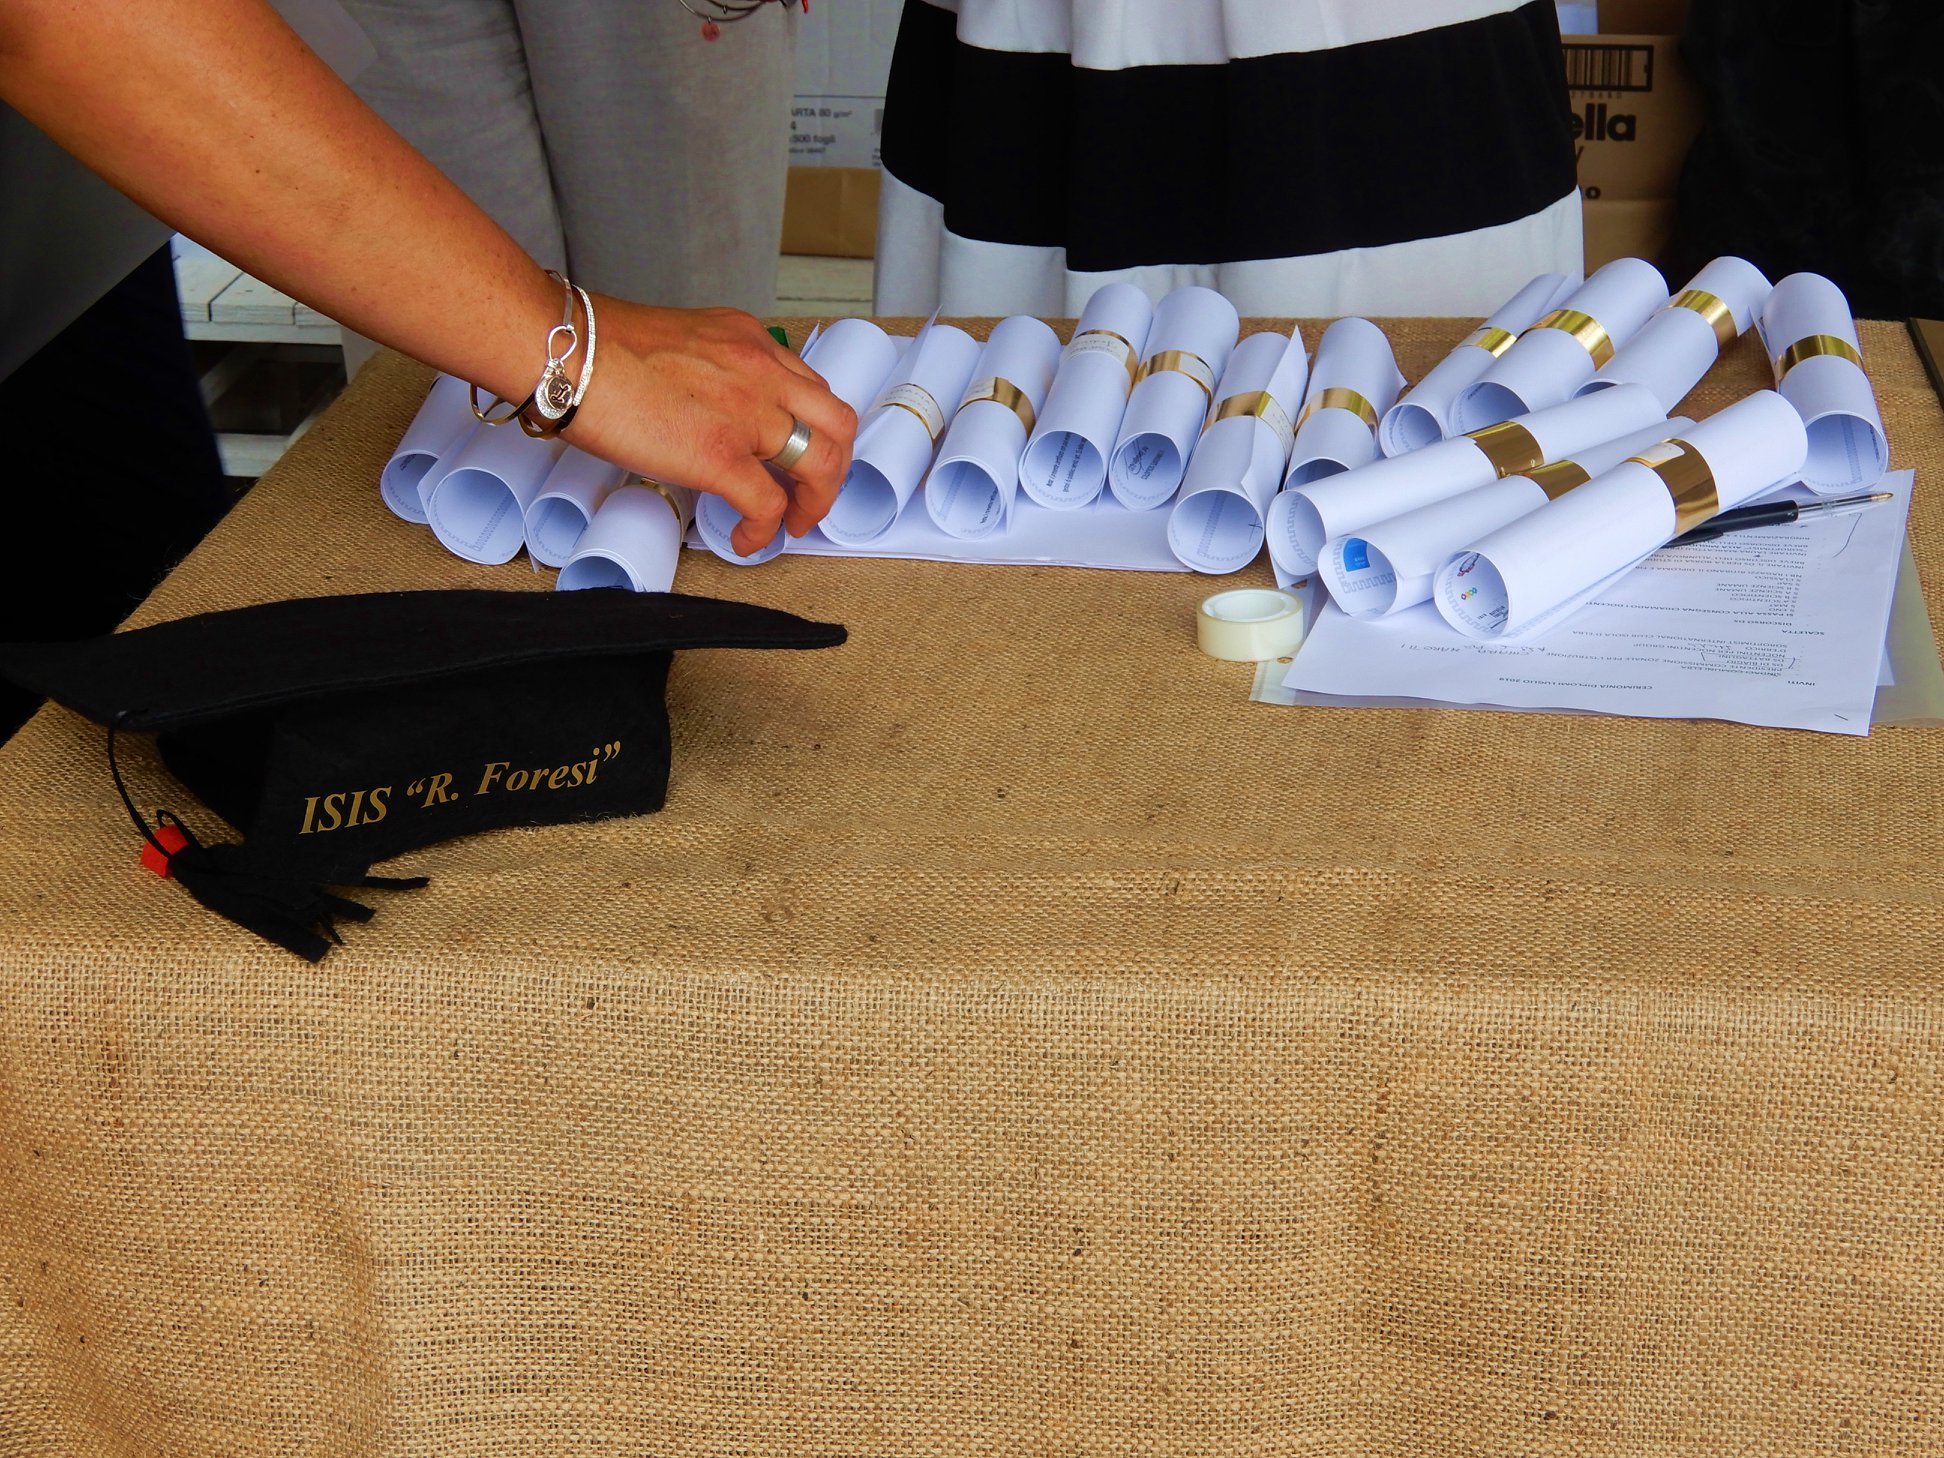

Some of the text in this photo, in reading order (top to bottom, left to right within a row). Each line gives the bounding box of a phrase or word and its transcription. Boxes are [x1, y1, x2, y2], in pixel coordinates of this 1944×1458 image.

[299, 740, 621, 835] ISIS “R. Foresi”
